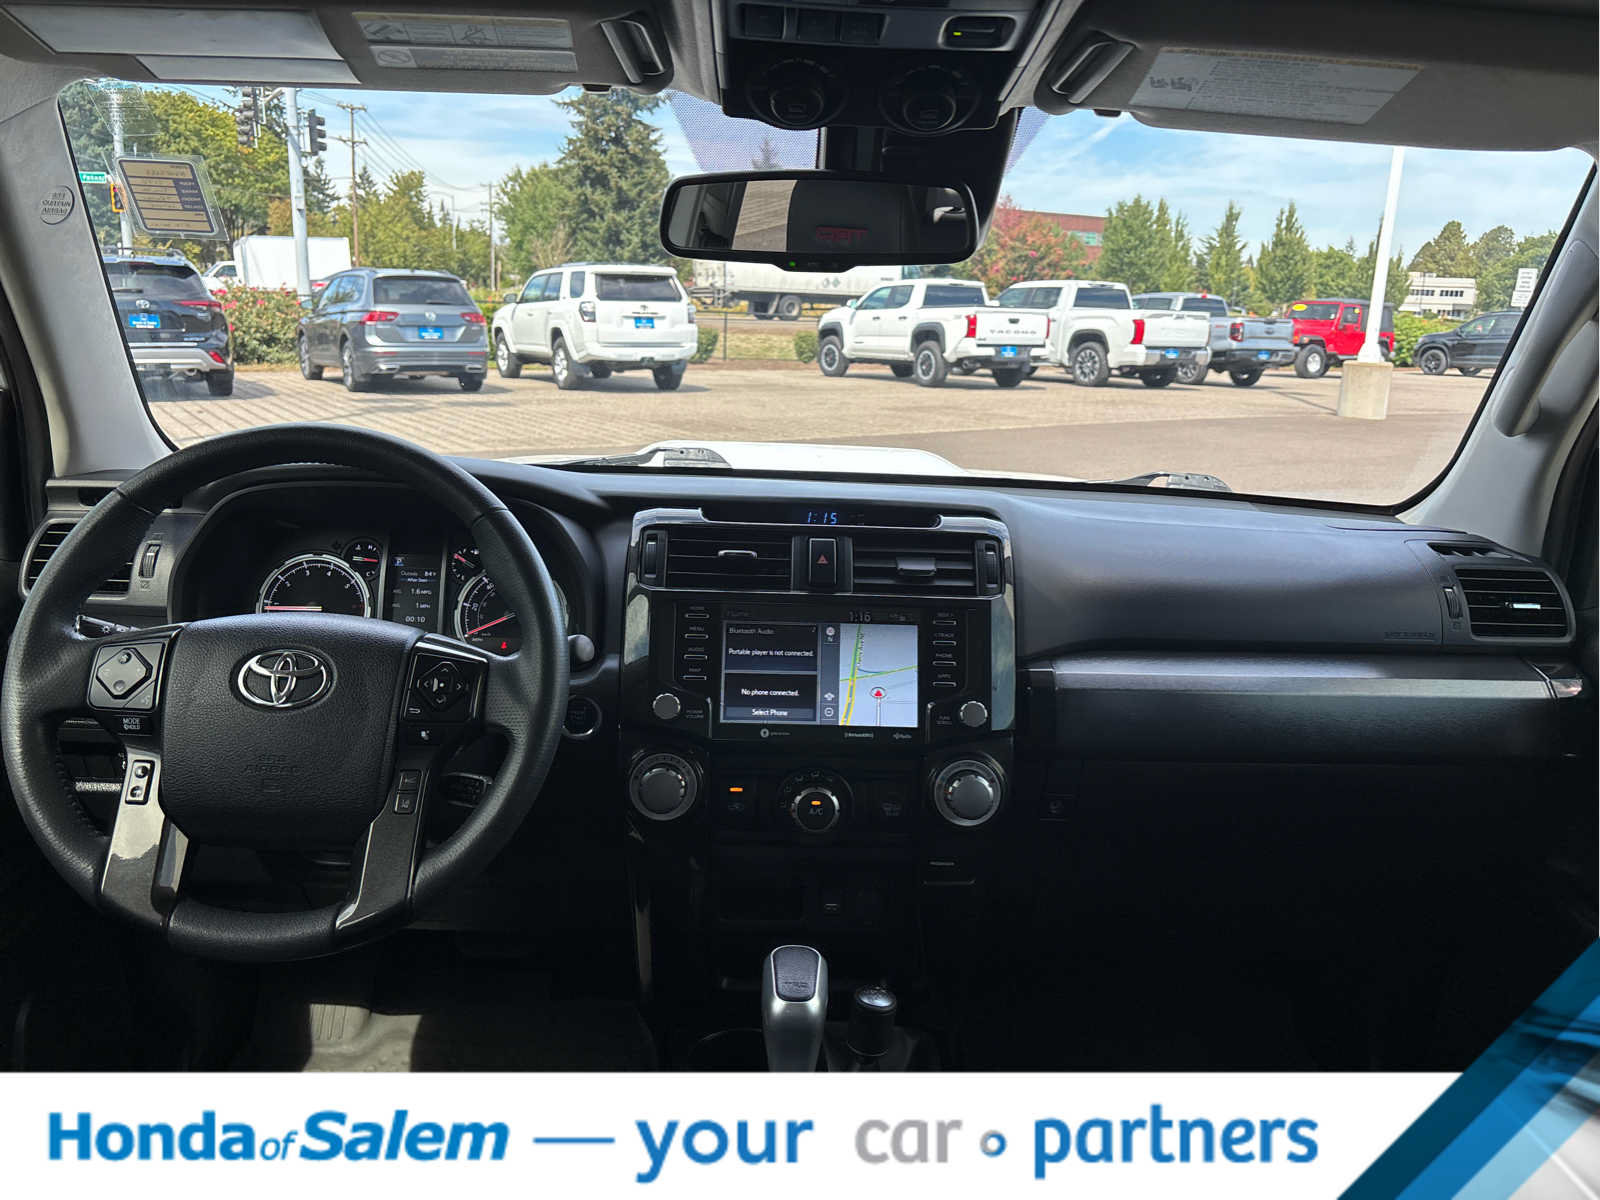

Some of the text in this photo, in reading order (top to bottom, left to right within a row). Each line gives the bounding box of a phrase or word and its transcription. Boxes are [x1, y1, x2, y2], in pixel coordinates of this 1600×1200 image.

[807, 511, 837, 524] 1:15
[305, 569, 311, 577] 3
[326, 569, 332, 577] 4
[850, 611, 871, 622] 1:16
[728, 648, 751, 656] Portable
[751, 649, 768, 658] player
[774, 649, 784, 657] not
[784, 649, 815, 657] connected.
[741, 688, 800, 698] No phone connected.
[751, 708, 788, 717] Select Phone
[122, 717, 141, 725] MODE
